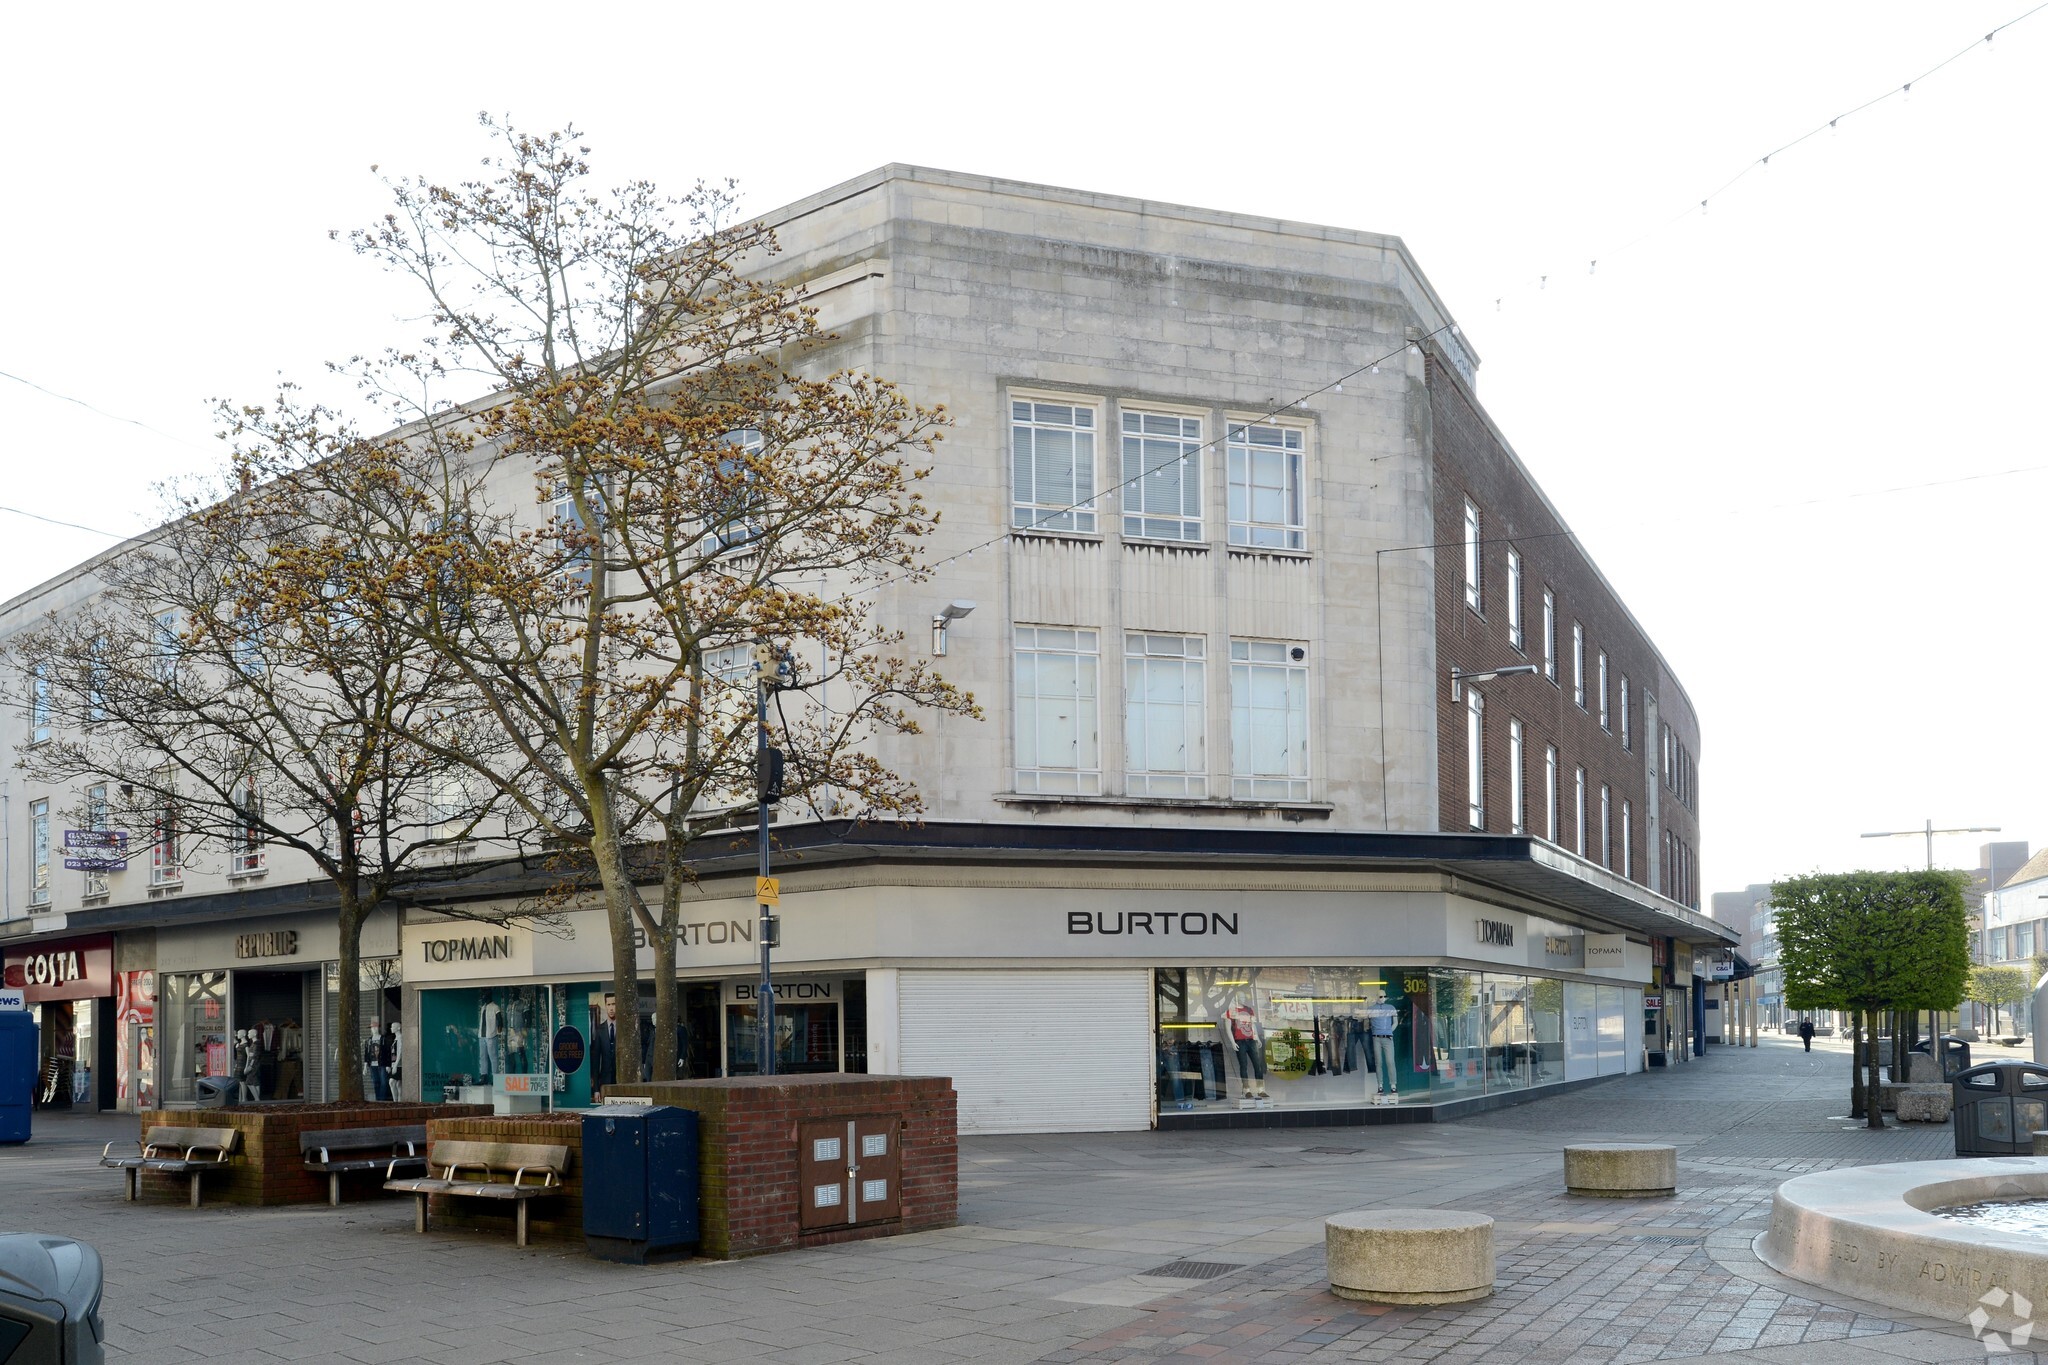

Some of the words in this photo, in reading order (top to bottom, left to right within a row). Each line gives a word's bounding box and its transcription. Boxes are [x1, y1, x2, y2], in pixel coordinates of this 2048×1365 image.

[633, 919, 752, 949] BRTON
[1067, 911, 1239, 935] BURTON
[1478, 918, 1514, 947] TOPMAN
[235, 930, 297, 959] REPUBLIC
[421, 935, 508, 963] TOPMAN
[1545, 936, 1572, 957] BURTON
[1588, 947, 1622, 955] TOPMAN
[24, 950, 79, 987] COSTA
[1403, 979, 1428, 993] 30%
[1645, 999, 1662, 1008] SALE
[505, 1076, 530, 1091] SALE
[1877, 1251, 1898, 1272] BY
